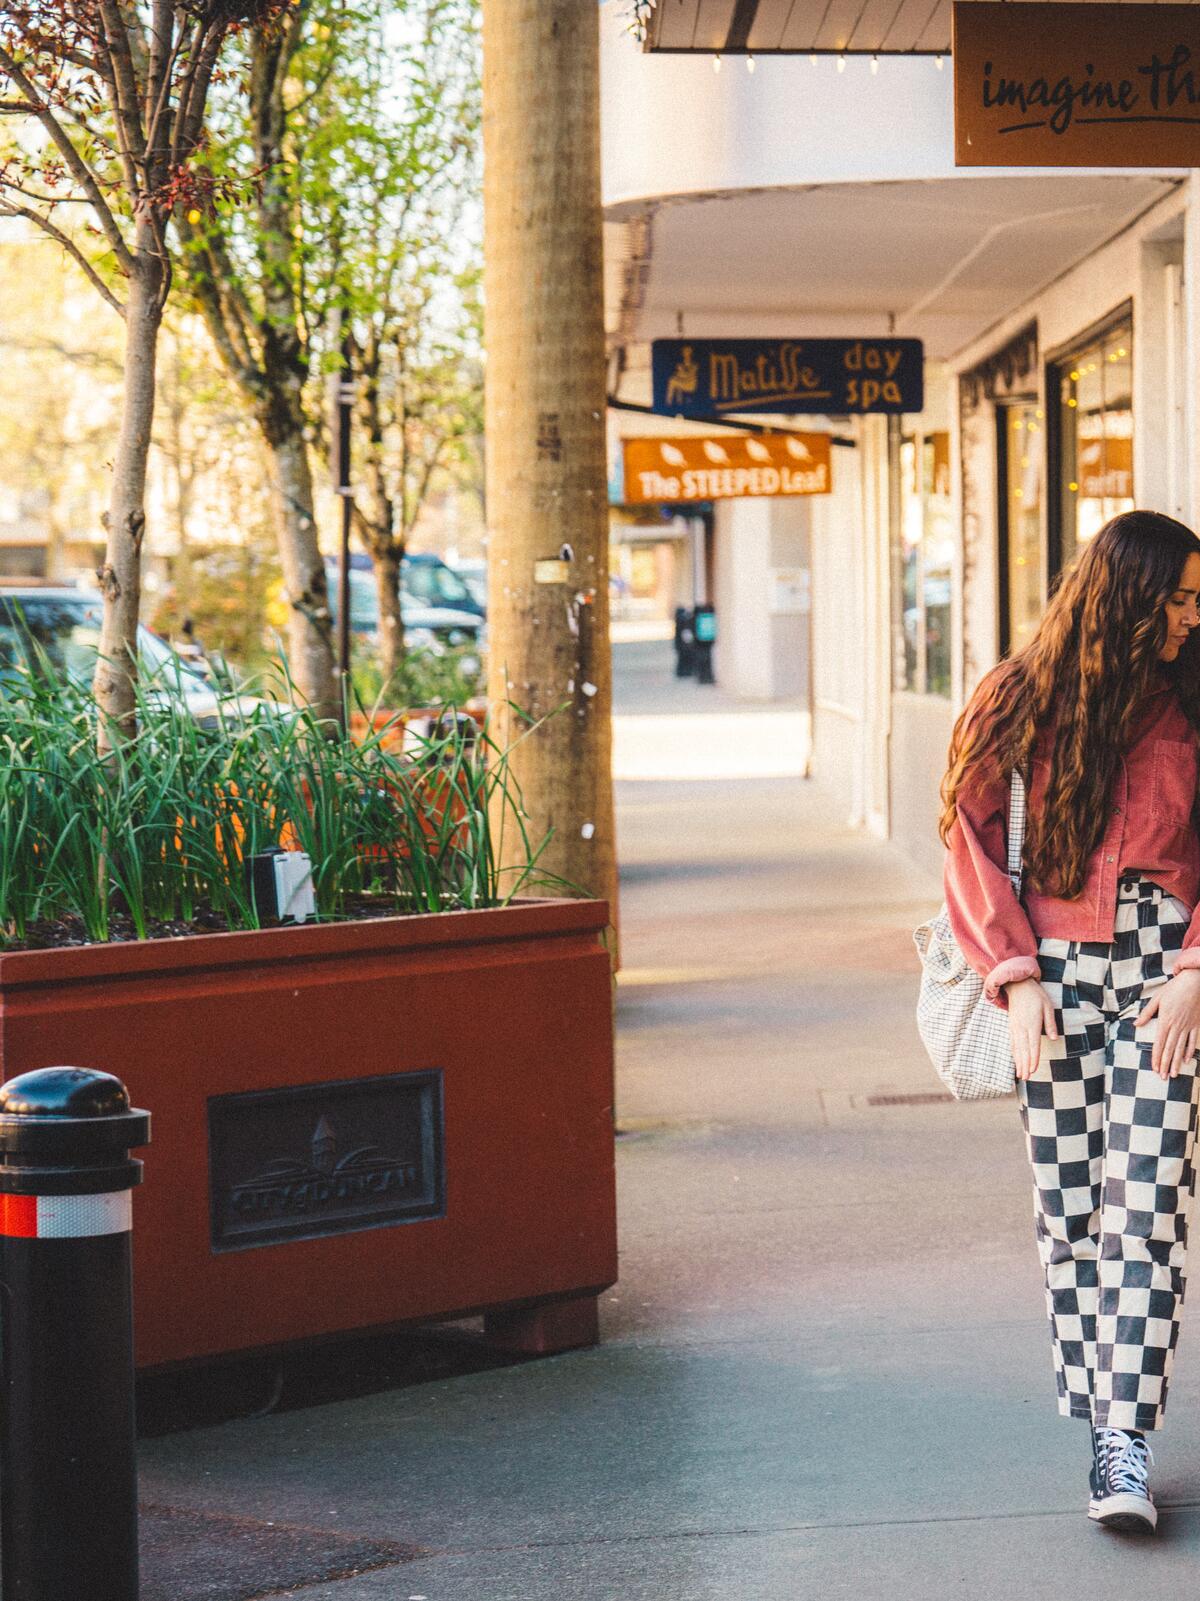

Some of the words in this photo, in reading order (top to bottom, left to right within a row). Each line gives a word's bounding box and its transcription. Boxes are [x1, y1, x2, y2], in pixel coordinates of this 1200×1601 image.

[982, 61, 1138, 135] imagine
[709, 343, 821, 399] Matisse
[843, 344, 901, 377] day
[847, 379, 903, 409] spa
[639, 470, 680, 498] The
[681, 466, 780, 498] STEEPED
[780, 463, 827, 493] Leaf
